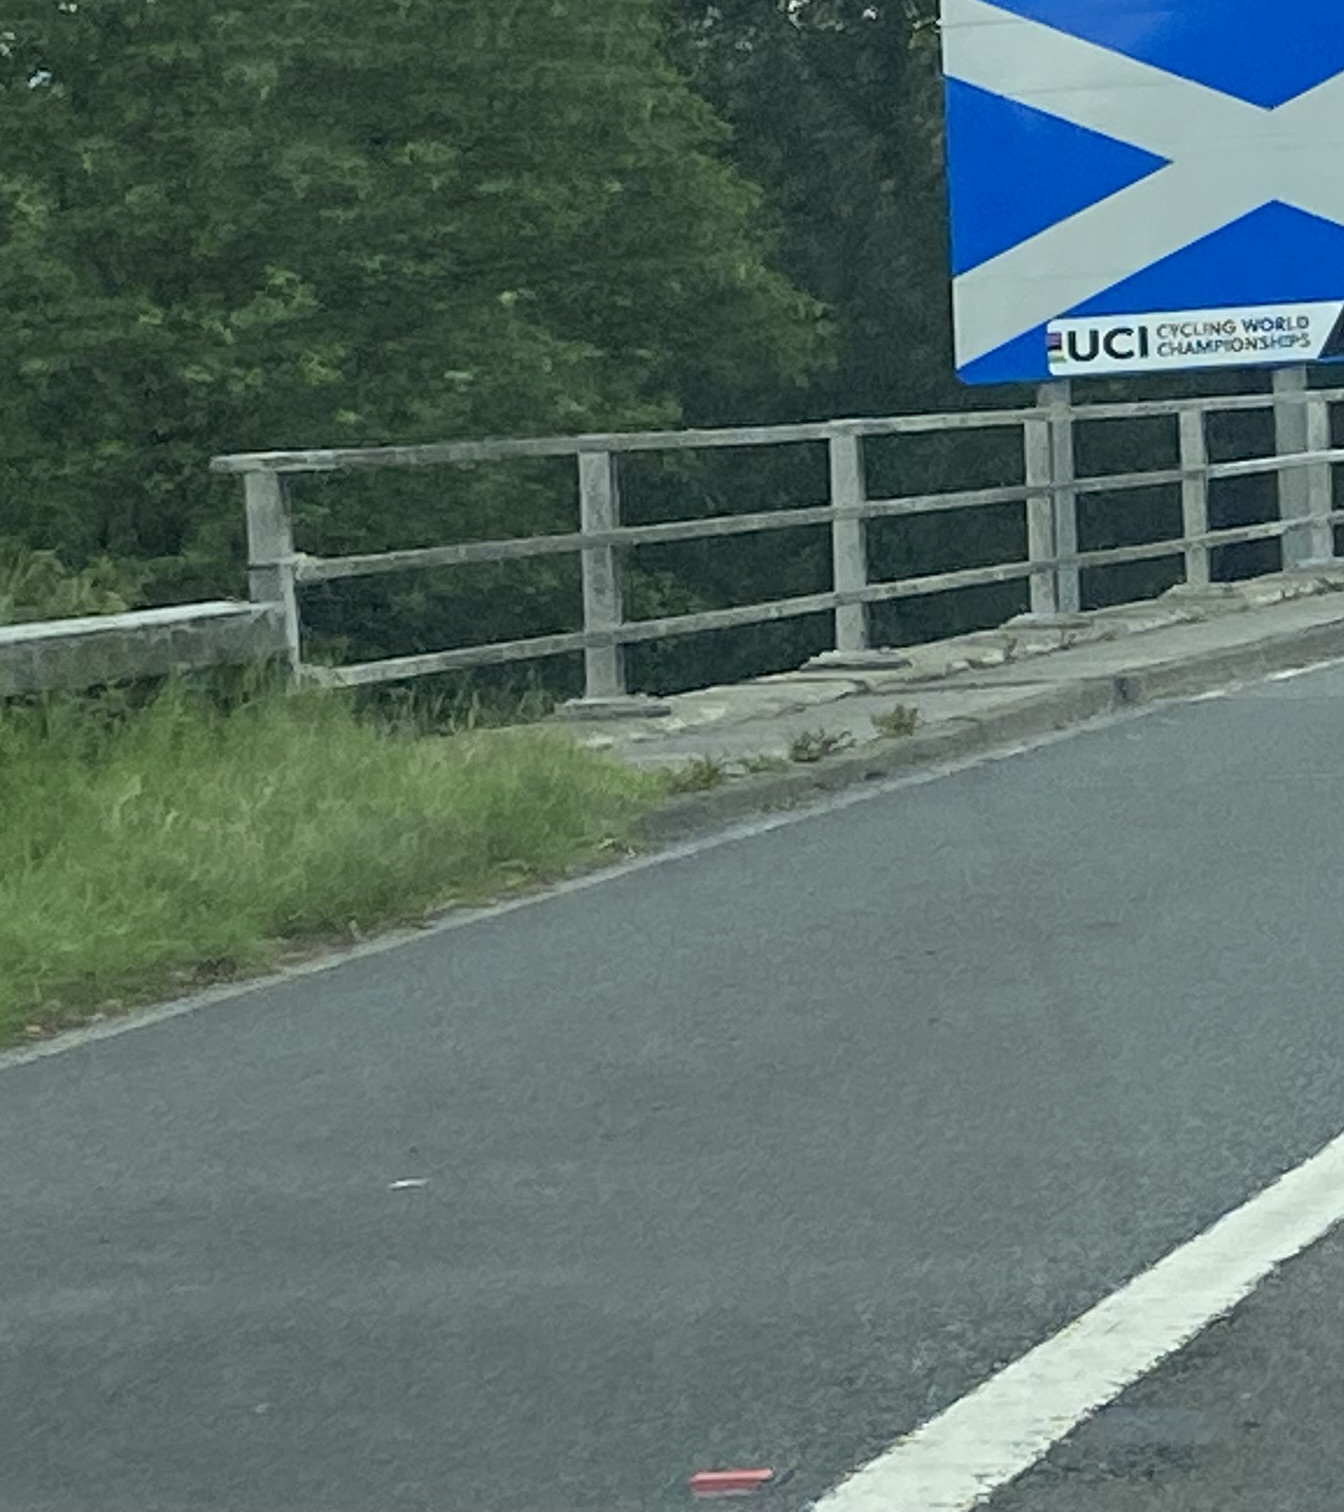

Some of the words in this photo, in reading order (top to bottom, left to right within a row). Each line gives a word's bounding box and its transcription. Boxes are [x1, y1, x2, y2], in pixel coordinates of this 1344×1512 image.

[1156, 319, 1237, 339] CYCLING
[1241, 316, 1309, 334] WORLD
[1067, 326, 1149, 363] UCI
[1156, 333, 1311, 358] CHAMPIONSHIPS
